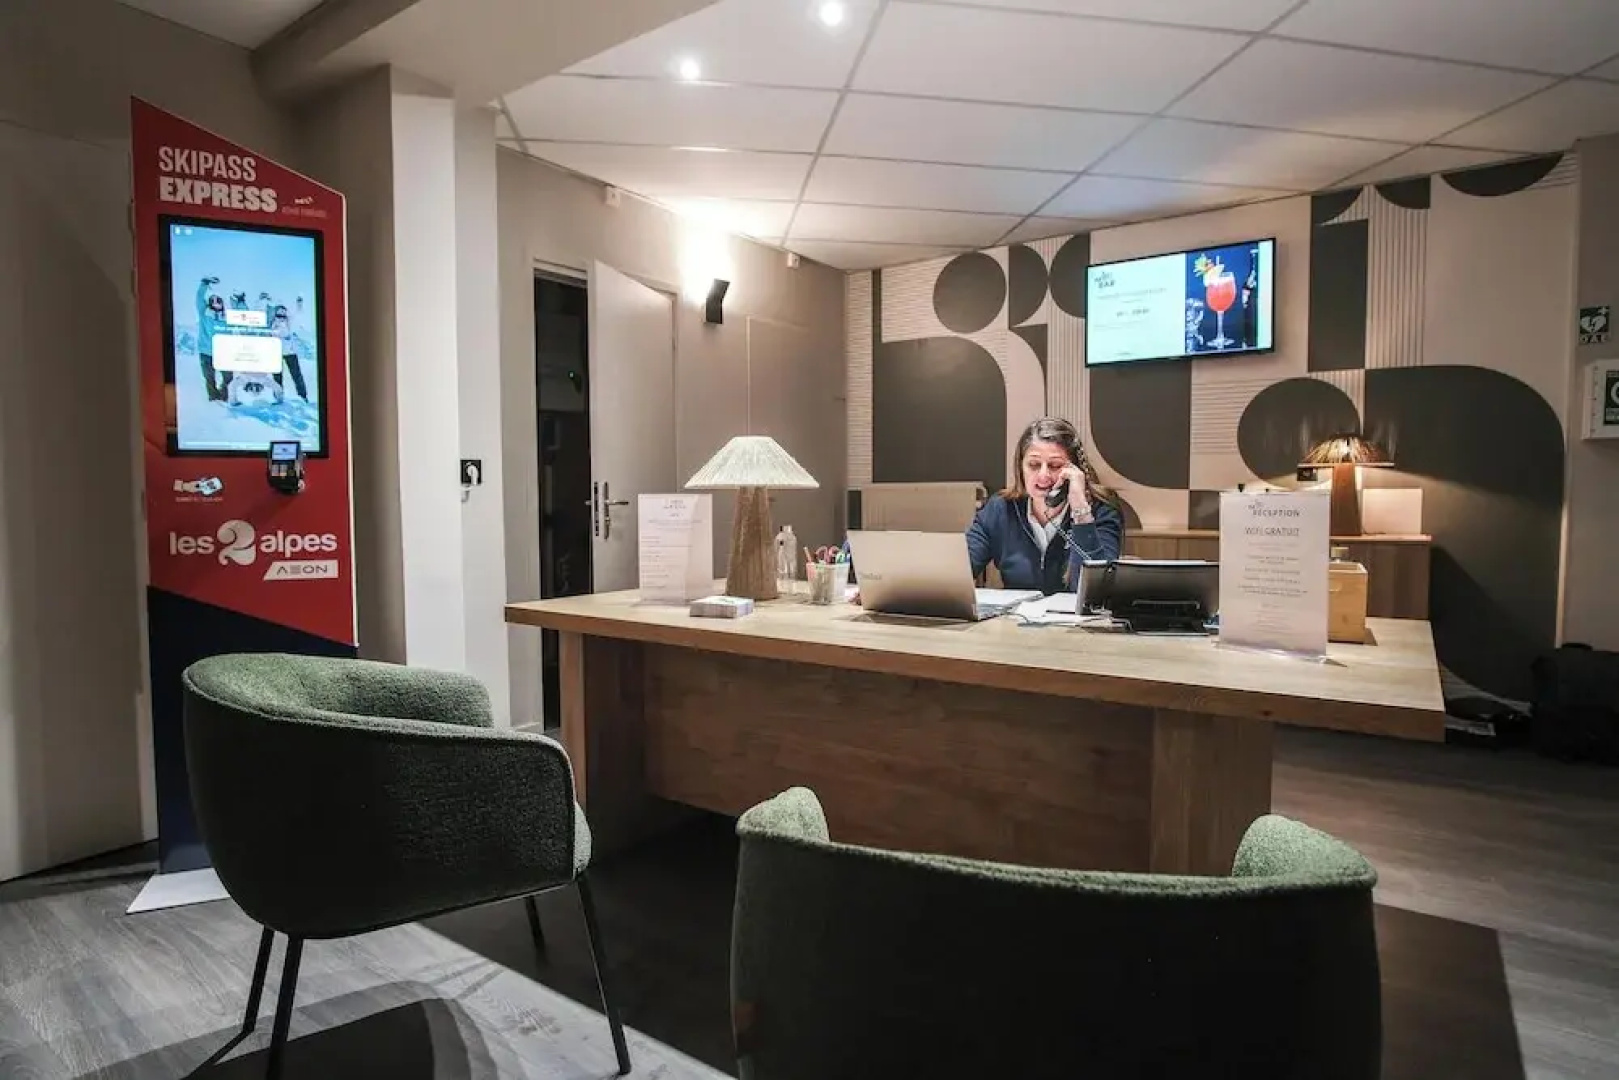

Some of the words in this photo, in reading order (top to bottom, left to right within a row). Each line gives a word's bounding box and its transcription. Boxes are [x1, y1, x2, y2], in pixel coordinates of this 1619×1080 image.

[158, 146, 257, 182] SKIPASS
[159, 176, 278, 213] EXPRESS
[169, 531, 215, 555] les
[216, 519, 257, 566] 2
[260, 530, 338, 558] alpes
